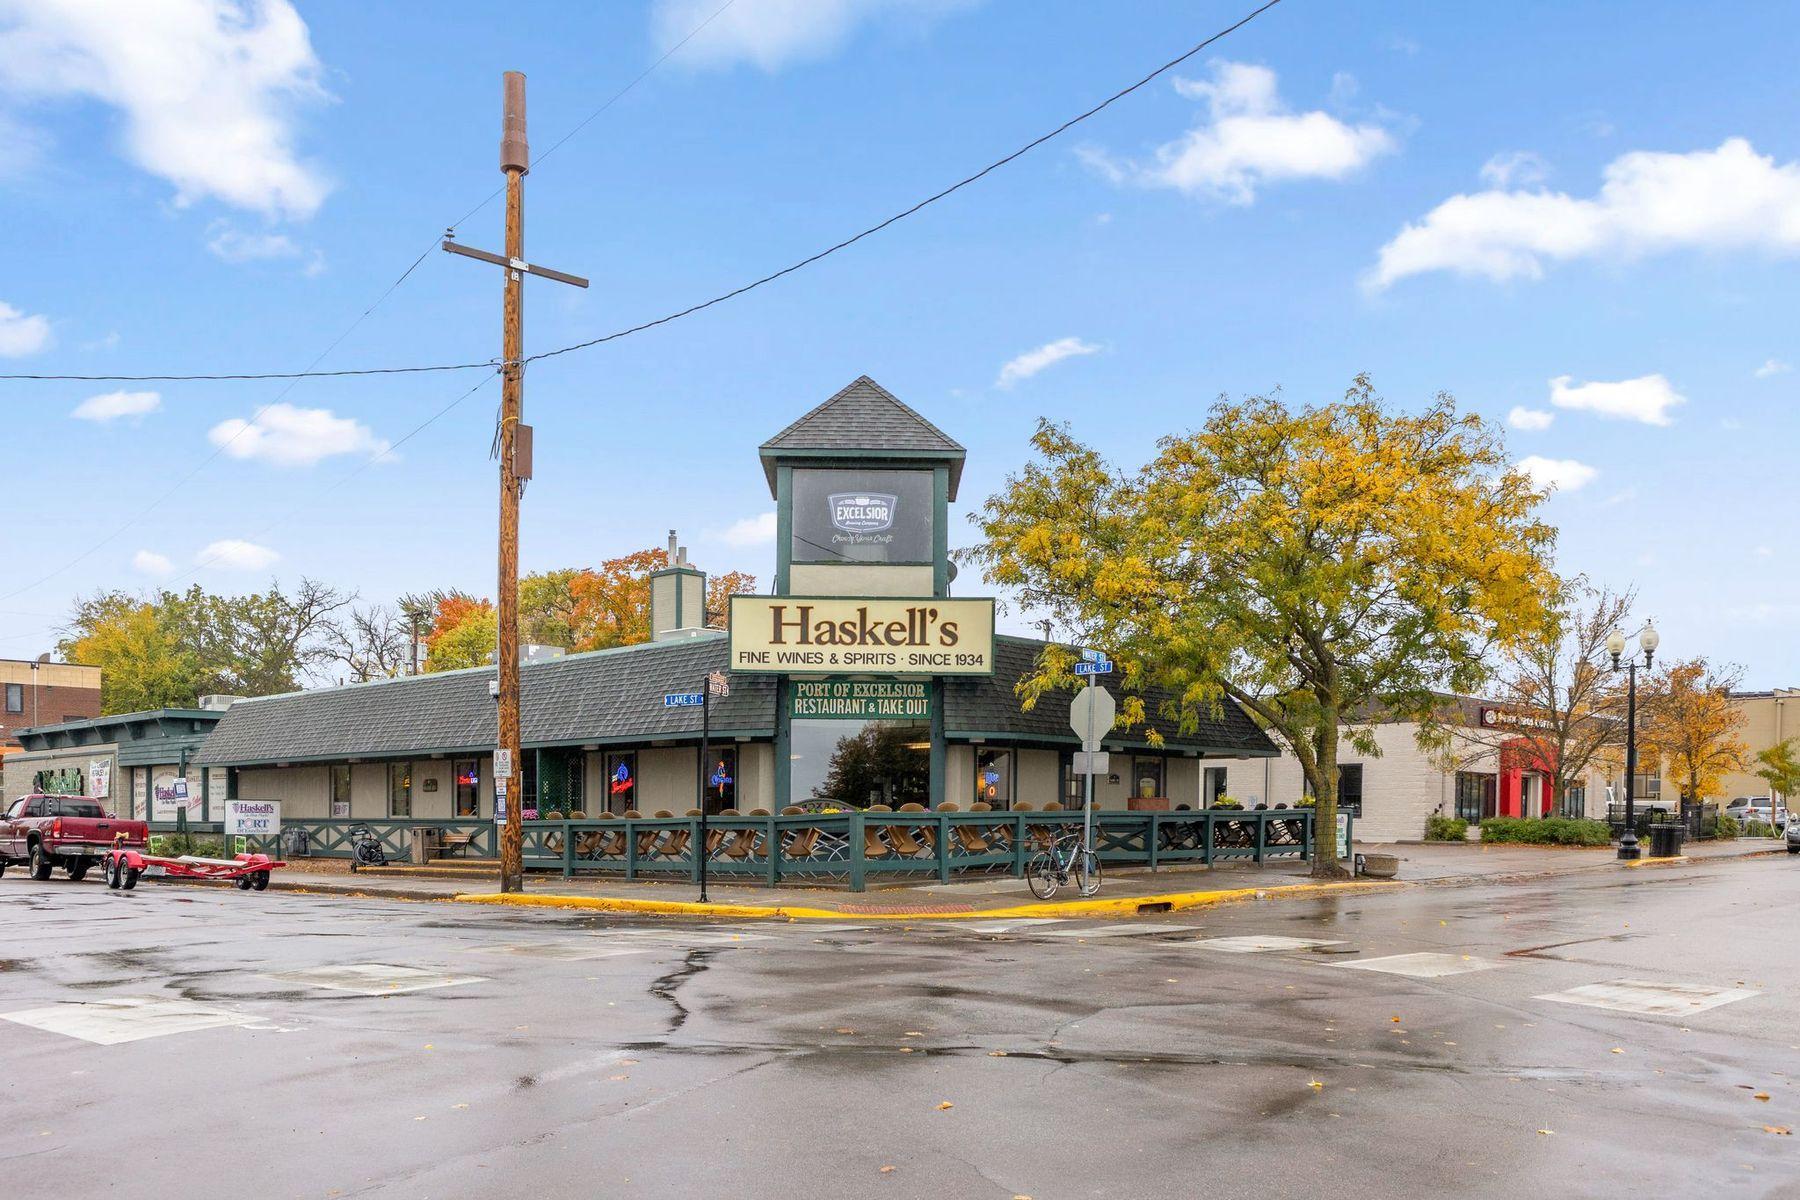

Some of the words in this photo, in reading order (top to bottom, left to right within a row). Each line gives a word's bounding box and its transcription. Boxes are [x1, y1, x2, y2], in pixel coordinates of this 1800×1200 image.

[837, 506, 888, 521] EXCELSIOR
[769, 605, 959, 647] Haskell's
[739, 651, 770, 664] FINE
[777, 651, 824, 664] WINES
[829, 652, 839, 665] &
[843, 652, 896, 665] SPIRITS
[908, 653, 952, 666] SINCE
[954, 653, 984, 666] 1934
[1079, 663, 1096, 673] LAKE
[1099, 662, 1108, 672] ST
[797, 683, 831, 697] PORT
[833, 683, 851, 697] OF
[853, 683, 925, 698] EXCELSIOR
[670, 696, 688, 704] LAKE
[689, 695, 698, 704] ST
[795, 698, 867, 714] RESTAURANT
[868, 702, 876, 713] &
[878, 699, 904, 715] TAKE
[906, 699, 929, 715] OUT
[240, 803, 274, 814] Haskell's
